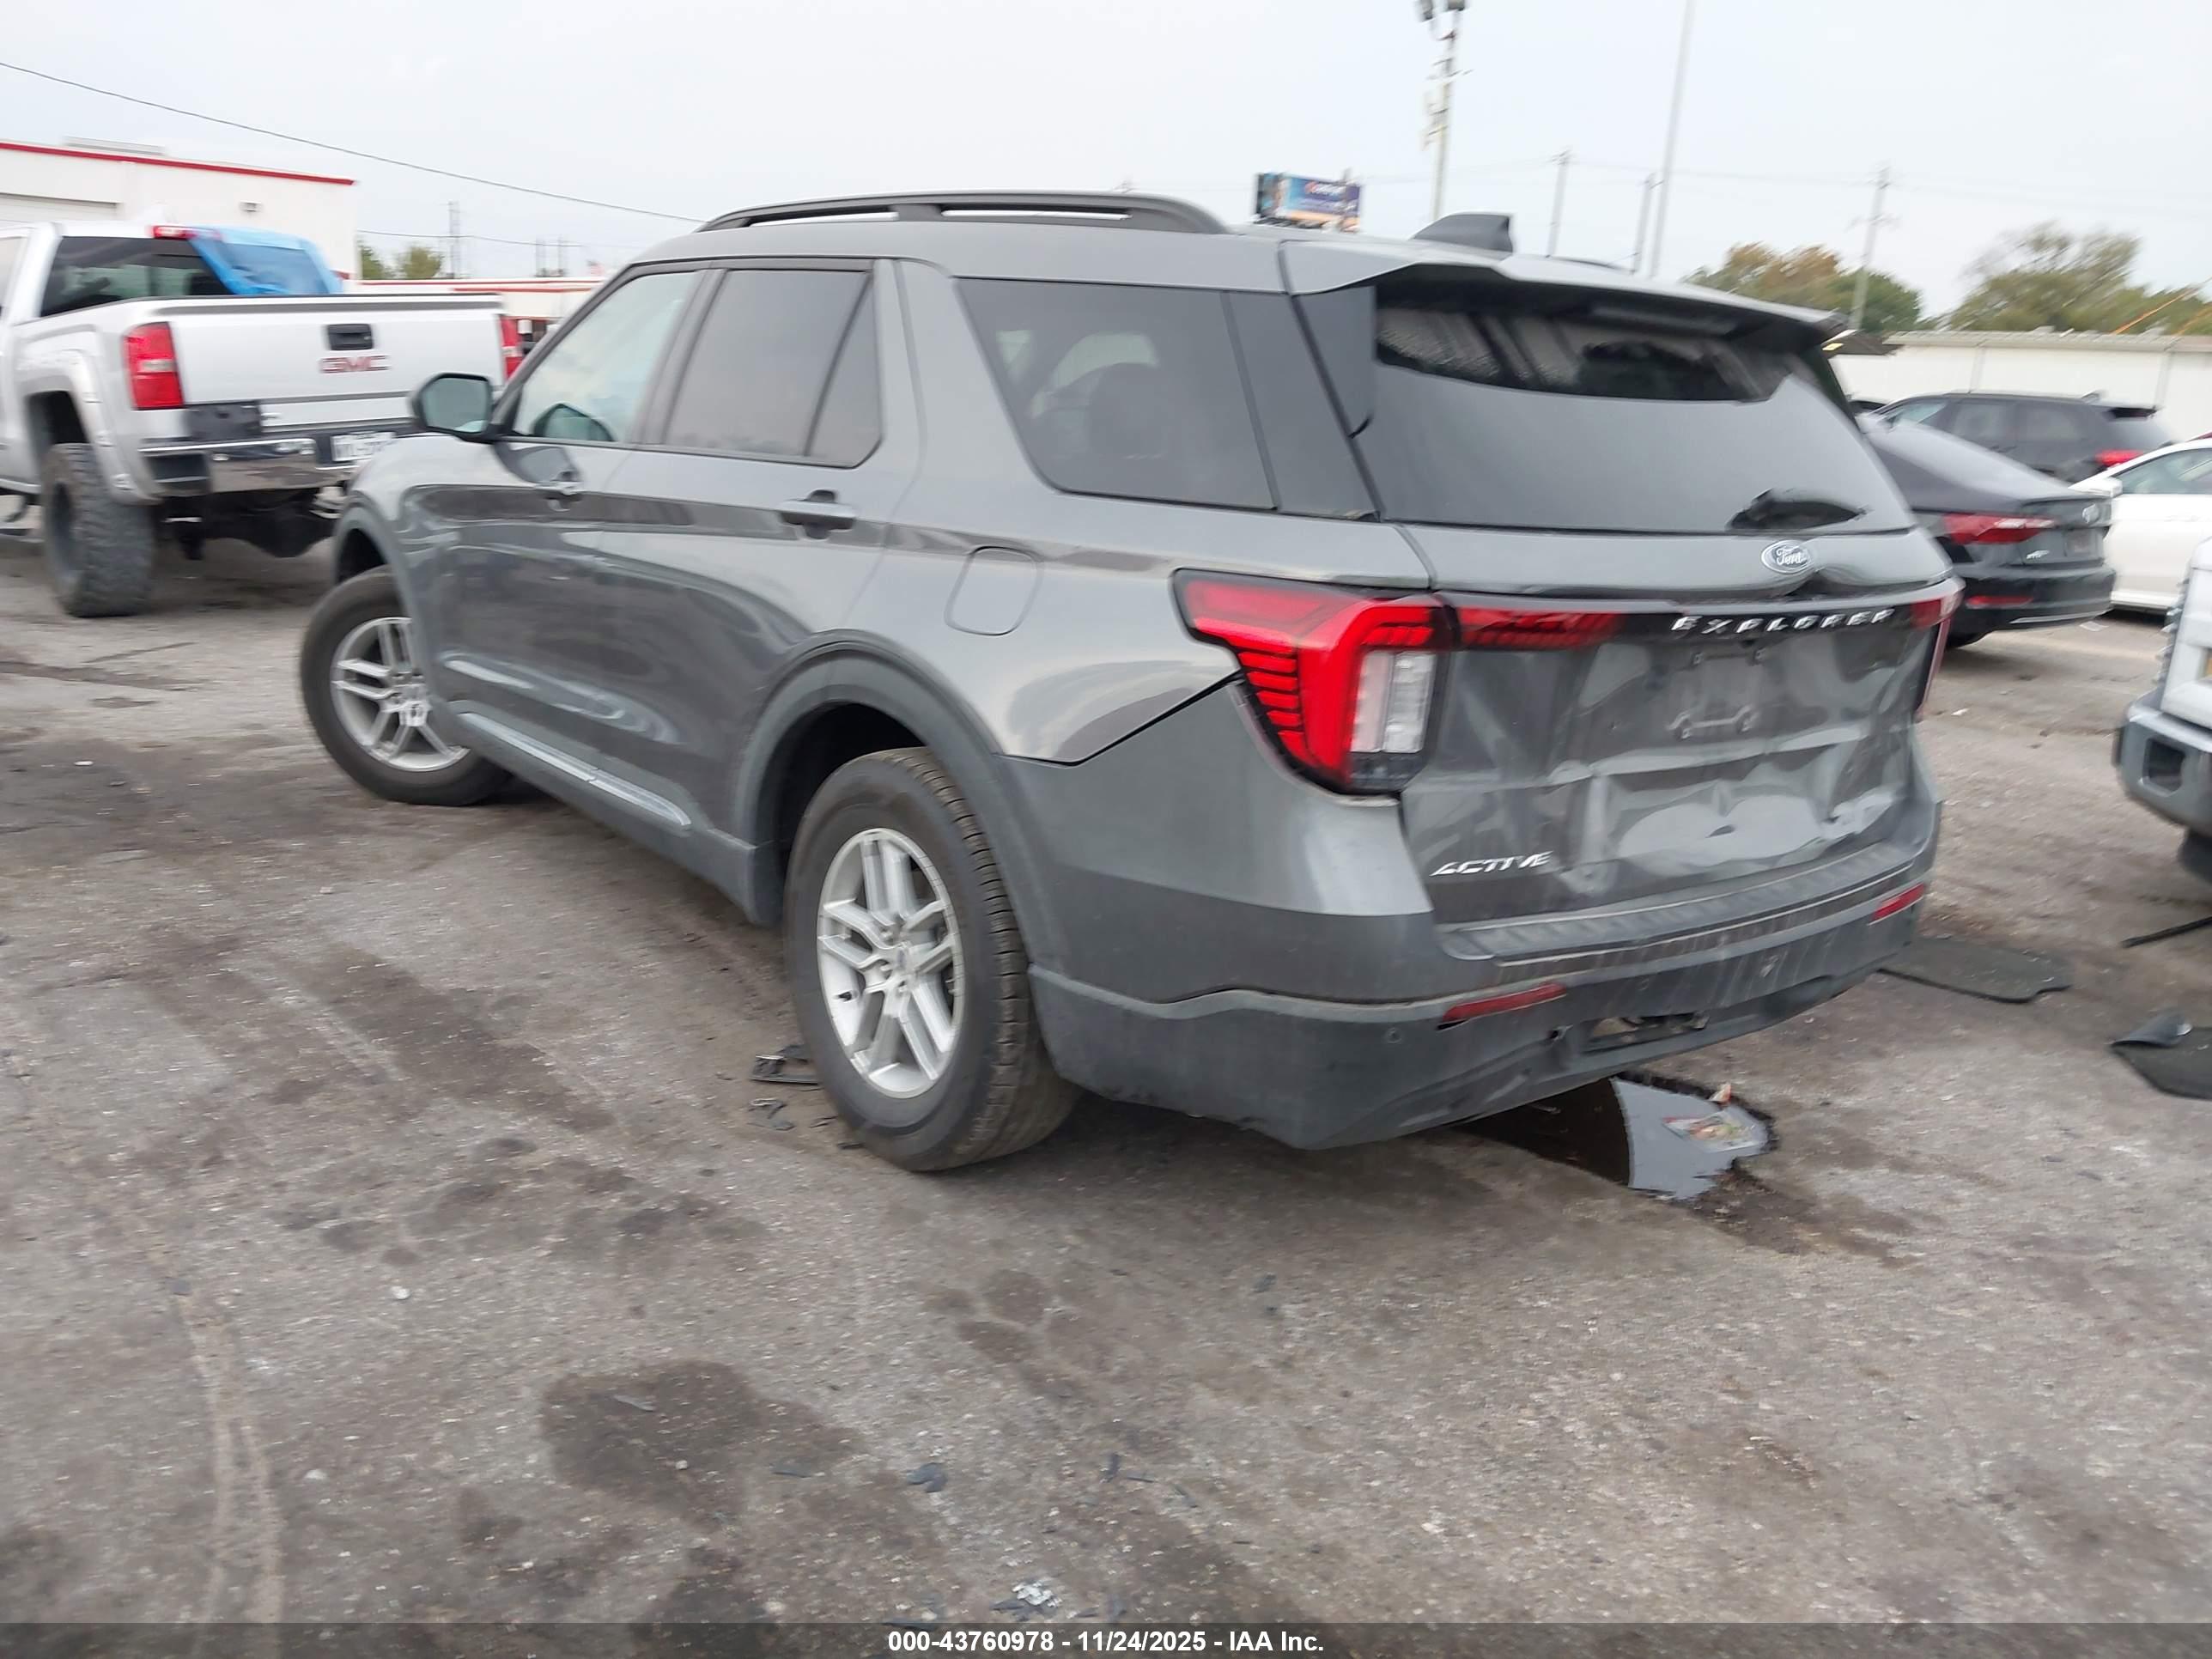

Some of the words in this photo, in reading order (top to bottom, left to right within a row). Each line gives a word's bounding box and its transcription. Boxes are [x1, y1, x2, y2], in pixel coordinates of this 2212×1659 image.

[319, 356, 390, 374] GMC
[1671, 608, 1895, 634] EXPLORER
[1429, 850, 1553, 877] ACTIVE
